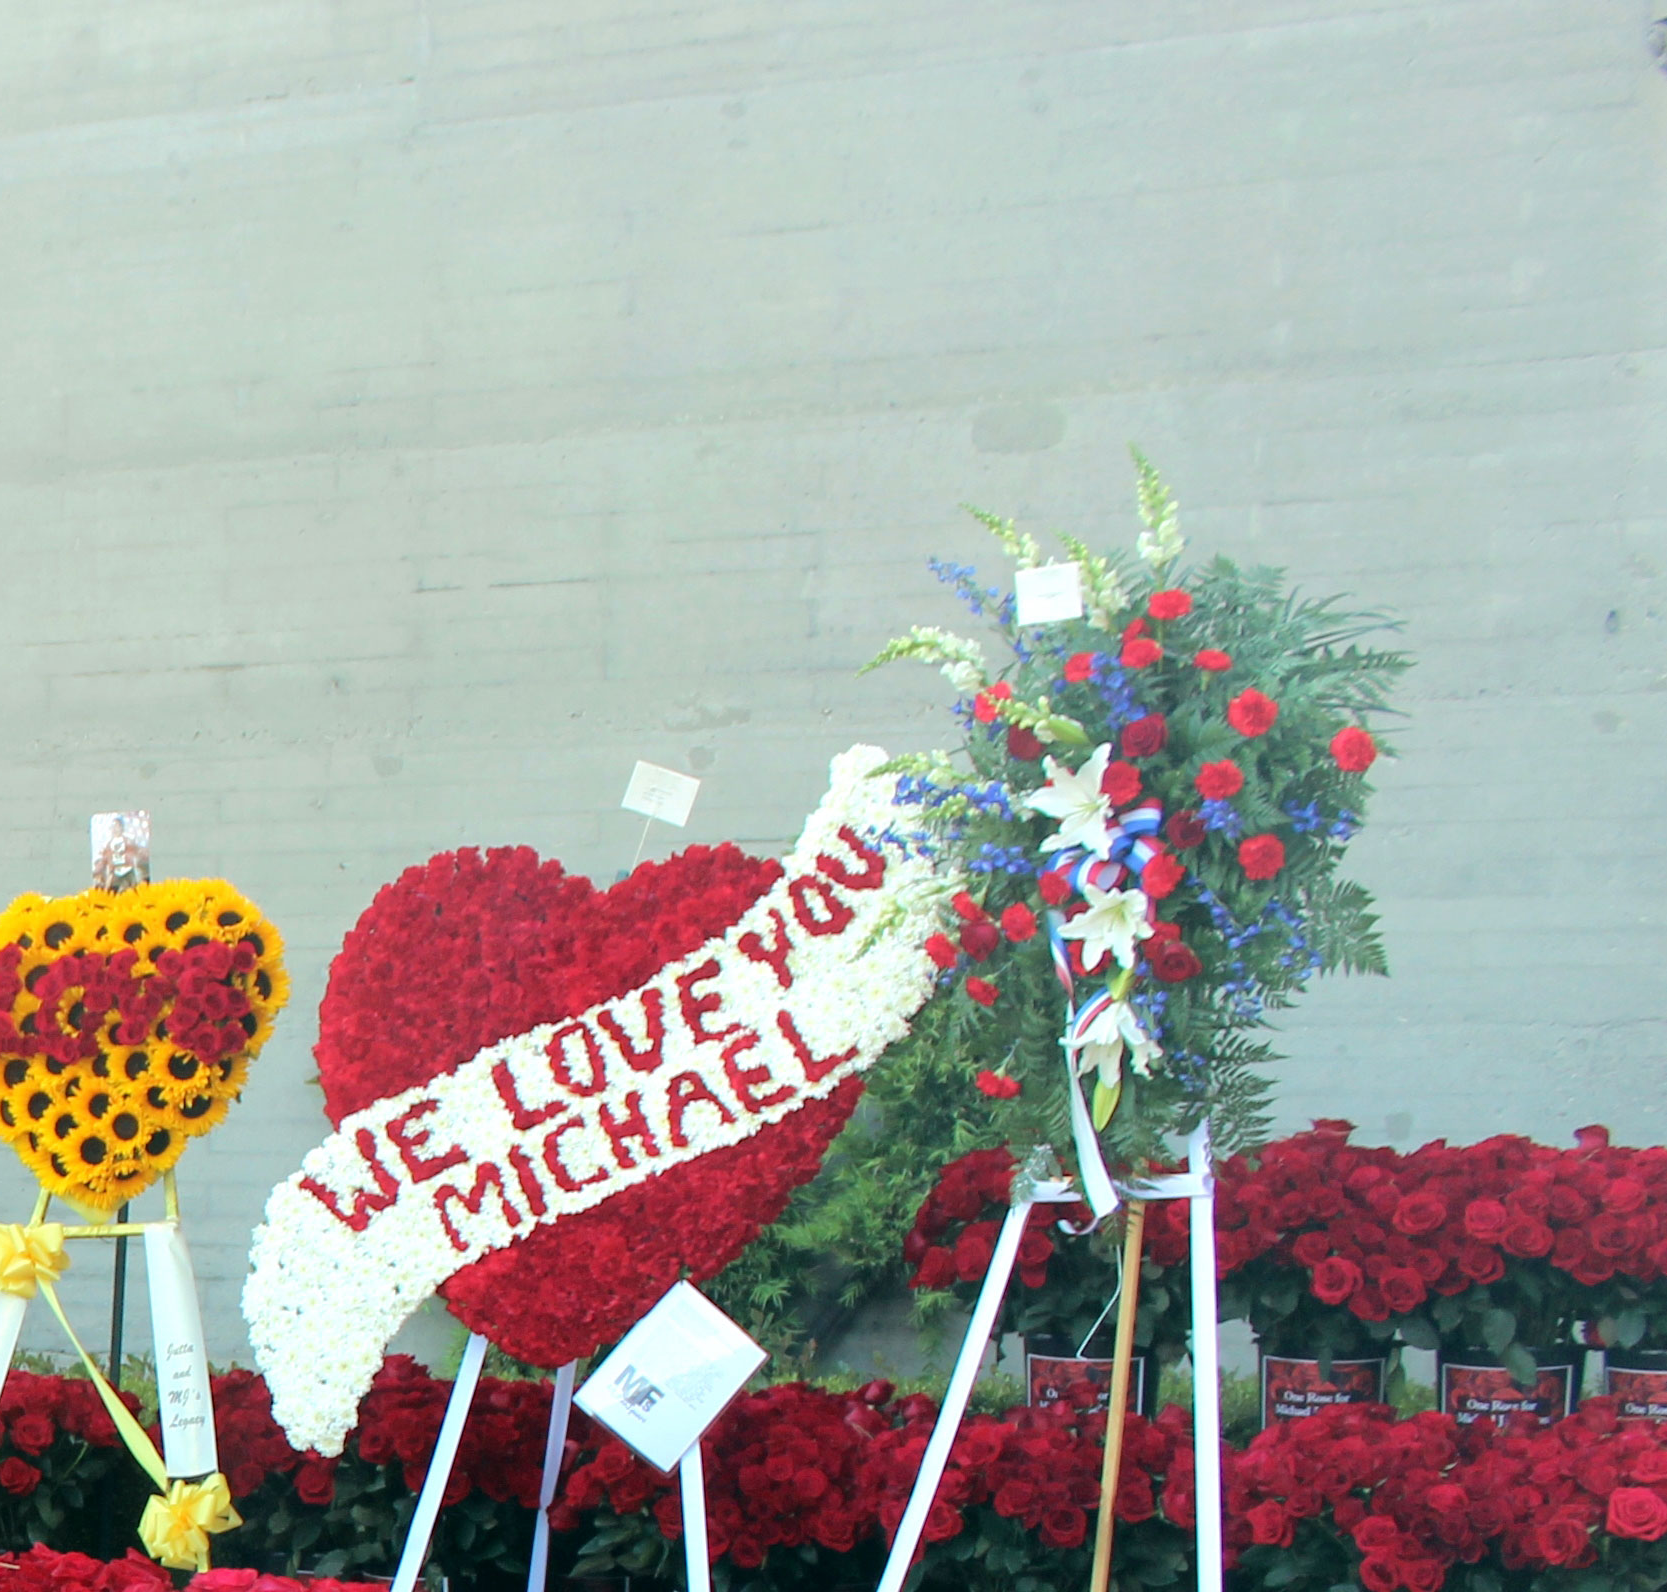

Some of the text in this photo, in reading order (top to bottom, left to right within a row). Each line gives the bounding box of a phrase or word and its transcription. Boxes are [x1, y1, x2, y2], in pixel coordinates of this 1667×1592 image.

[298, 825, 887, 1231] WE LOVE YOU
[434, 1010, 858, 1251] MICHAEL
[169, 1414, 205, 1430] Legacy
